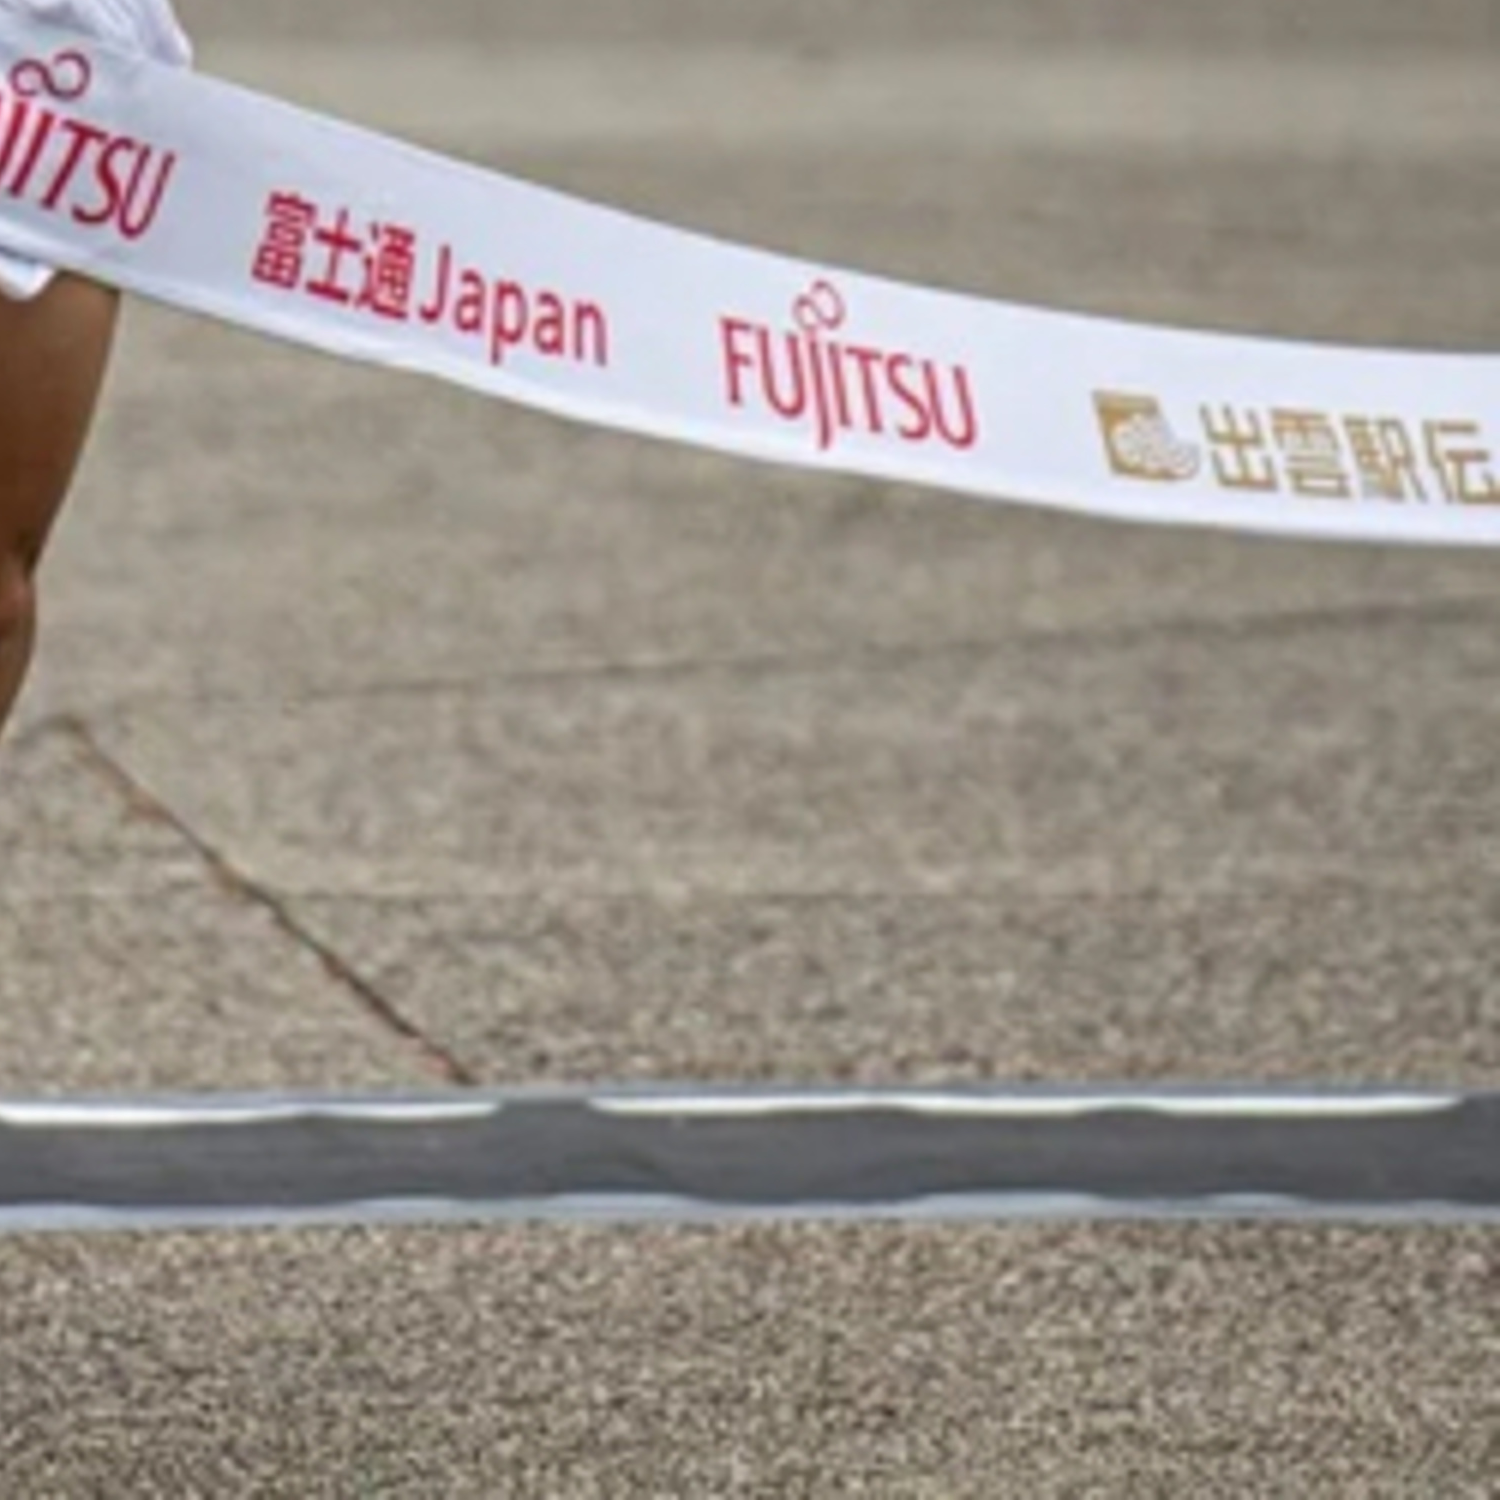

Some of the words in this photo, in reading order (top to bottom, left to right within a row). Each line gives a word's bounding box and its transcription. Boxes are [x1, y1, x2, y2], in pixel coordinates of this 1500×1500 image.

[251, 190, 608, 365] 富士通Japan
[720, 316, 978, 451] FUJITSU
[1200, 402, 1500, 506] 出雲駅伝
